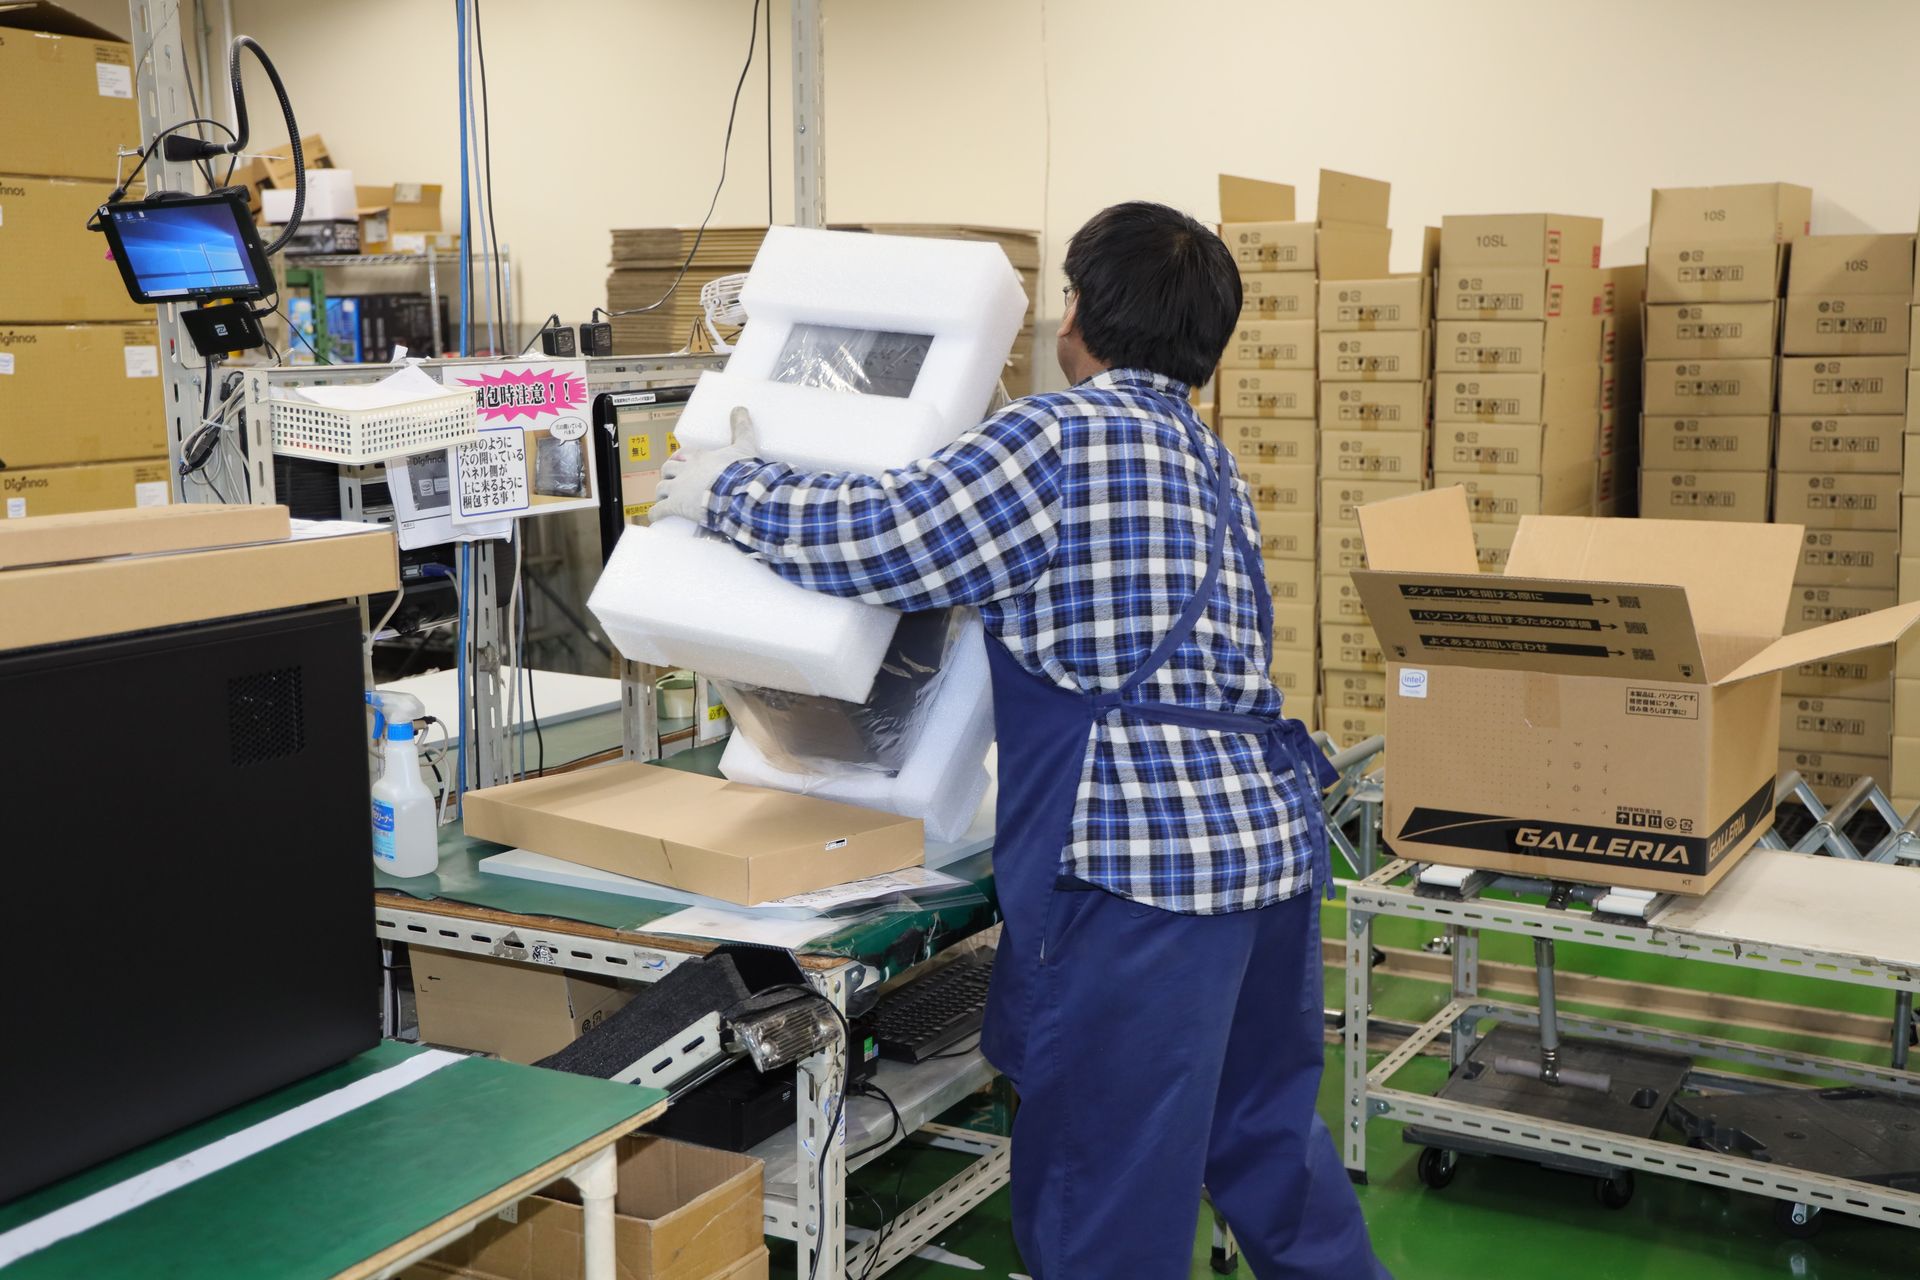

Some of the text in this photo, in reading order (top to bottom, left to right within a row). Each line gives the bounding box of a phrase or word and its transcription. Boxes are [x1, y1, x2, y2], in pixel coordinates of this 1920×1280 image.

[1703, 209, 1726, 222] 10S
[1475, 235, 1508, 247] 10SL
[1845, 260, 1868, 272] 10S
[460, 449, 524, 467] 穴の開いている
[631, 447, 647, 457] 無し
[461, 463, 508, 480] パネル側が
[4, 476, 48, 492] Diginnos
[462, 477, 523, 495] 上に来るように
[463, 490, 516, 509] 梱包する事!
[1407, 586, 1545, 601] ダンボールを開ける際に
[1418, 611, 1593, 629] パソコンを使用するための準備
[1429, 637, 1548, 651] よくあるお問い合わせ
[1515, 827, 1690, 865] GALLERIA
[1709, 813, 1746, 863] GALLERIA
[1681, 878, 1693, 886] KT
